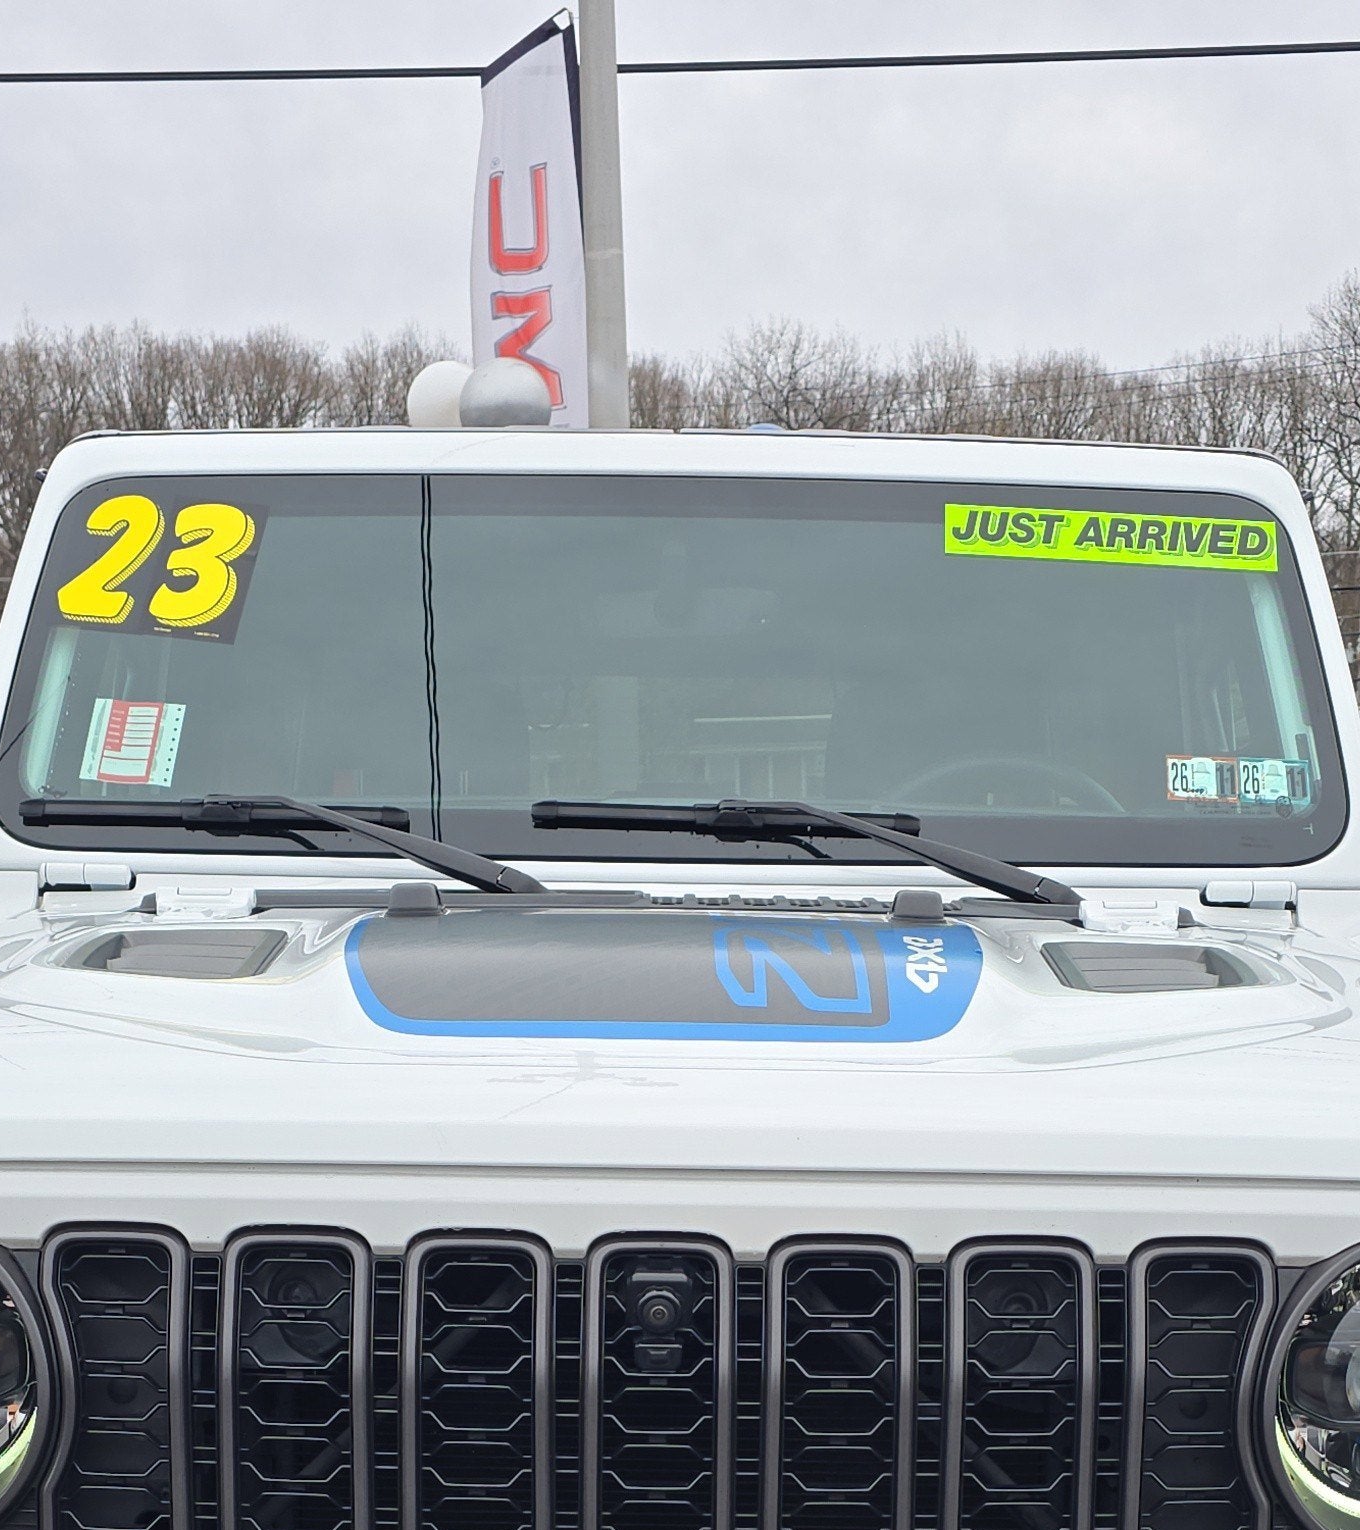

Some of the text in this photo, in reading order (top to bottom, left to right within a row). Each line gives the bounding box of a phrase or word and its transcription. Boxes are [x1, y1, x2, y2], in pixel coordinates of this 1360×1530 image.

[952, 509, 1275, 560] JUST ARRIVED
[57, 494, 256, 629] 23
[1171, 762, 1189, 792] 26
[1242, 764, 1260, 794] 26
